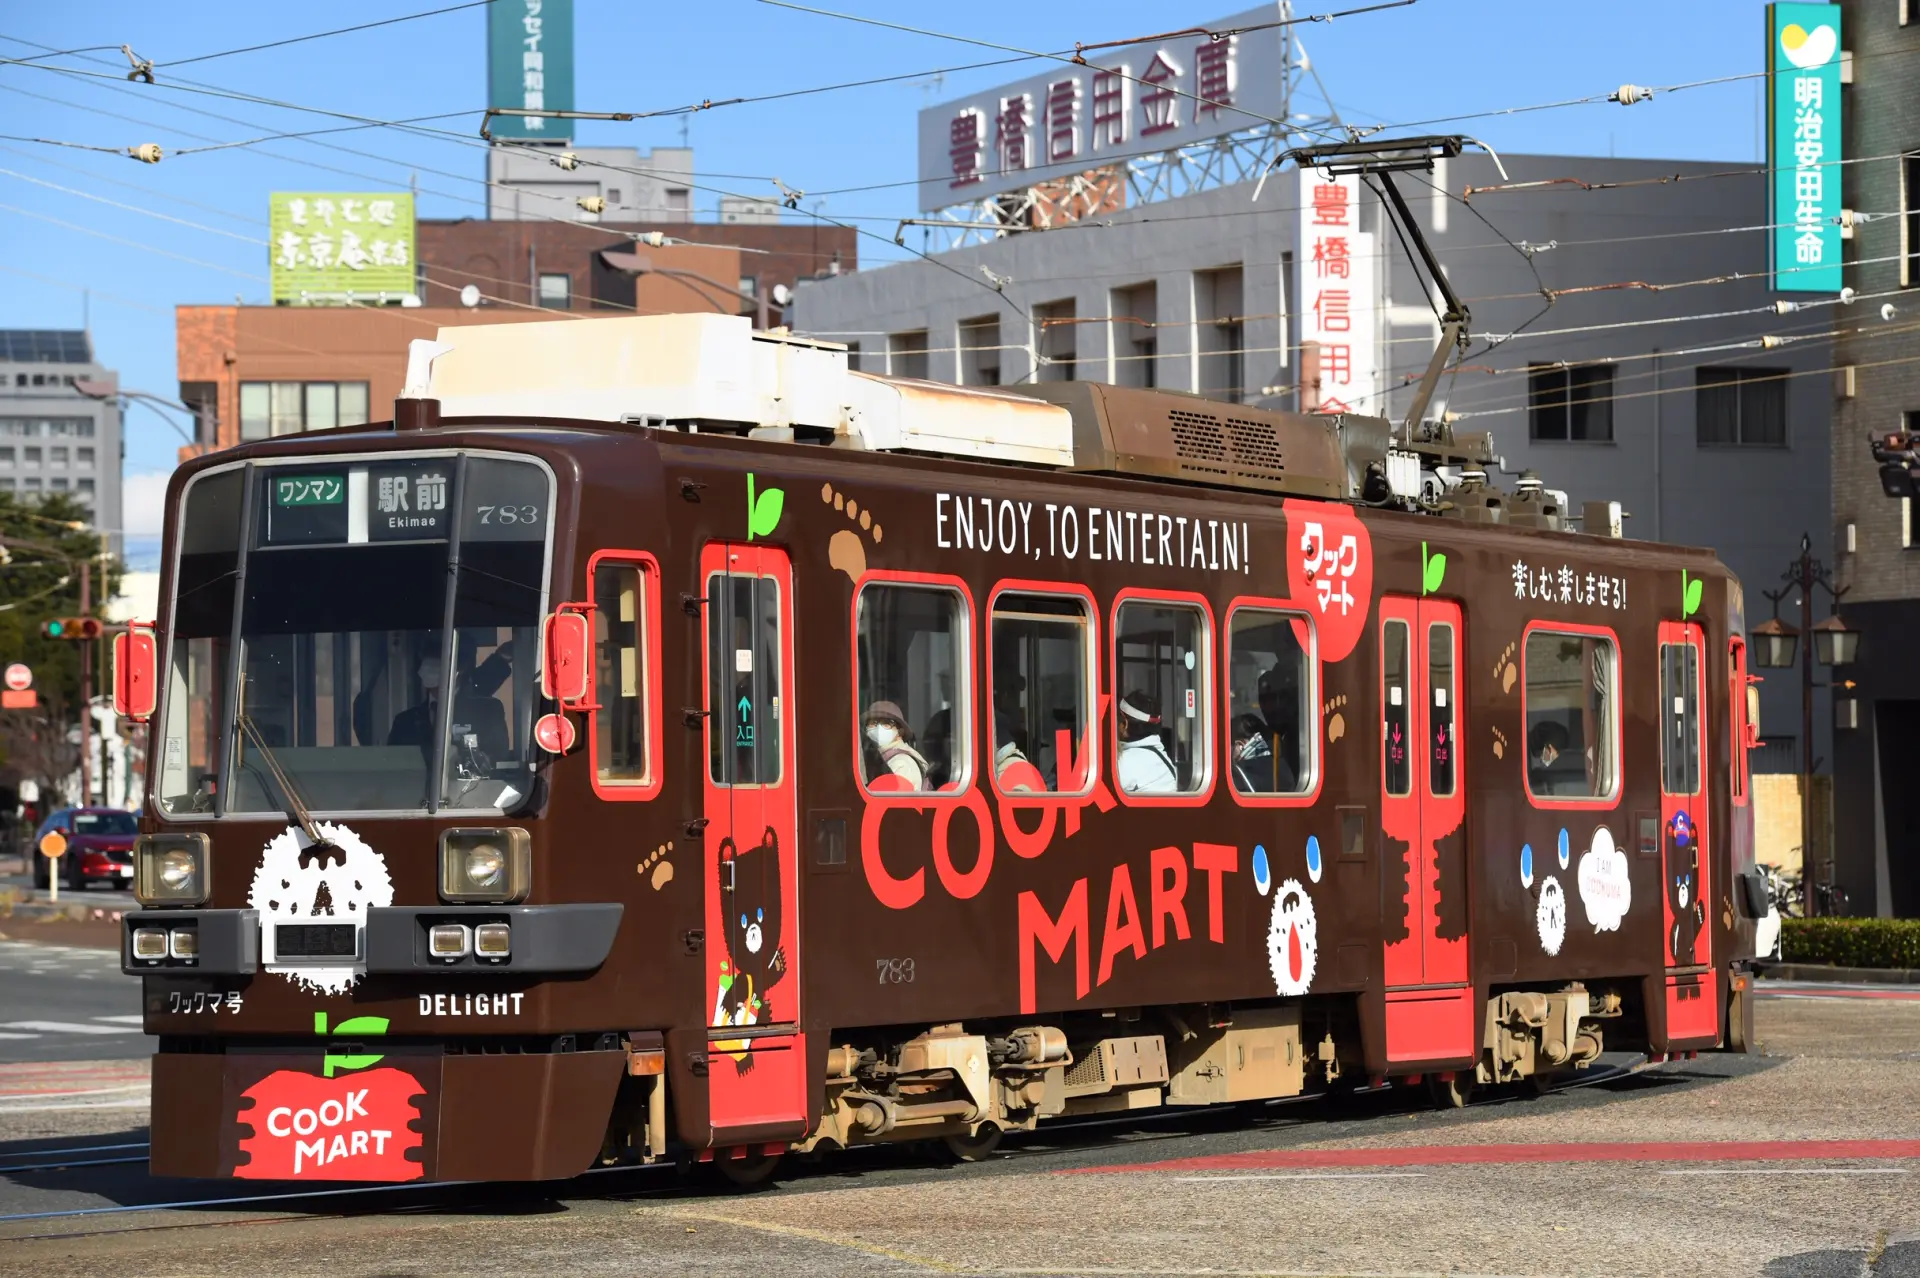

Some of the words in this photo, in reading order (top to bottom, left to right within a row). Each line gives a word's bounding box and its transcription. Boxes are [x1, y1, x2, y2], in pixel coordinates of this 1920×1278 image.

[950, 34, 1240, 189] 豊橋信用金庫
[1794, 77, 1824, 264] 明治安田生命
[280, 480, 340, 502] ワンマン
[378, 474, 447, 513] 駅前
[389, 517, 436, 528] Ekimae
[477, 505, 538, 525] 783
[1045, 504, 1079, 559] TO
[1088, 507, 1249, 574] ENTERTAIN!
[1301, 522, 1358, 577] クック
[1316, 580, 1355, 616] マート
[737, 725, 754, 740] 入口
[861, 692, 1118, 909] COOK
[1018, 842, 1238, 1015] MART
[876, 957, 915, 984] 783
[169, 991, 244, 1014] クックマ号
[266, 1089, 369, 1137] COOK
[294, 1129, 392, 1174] MART
